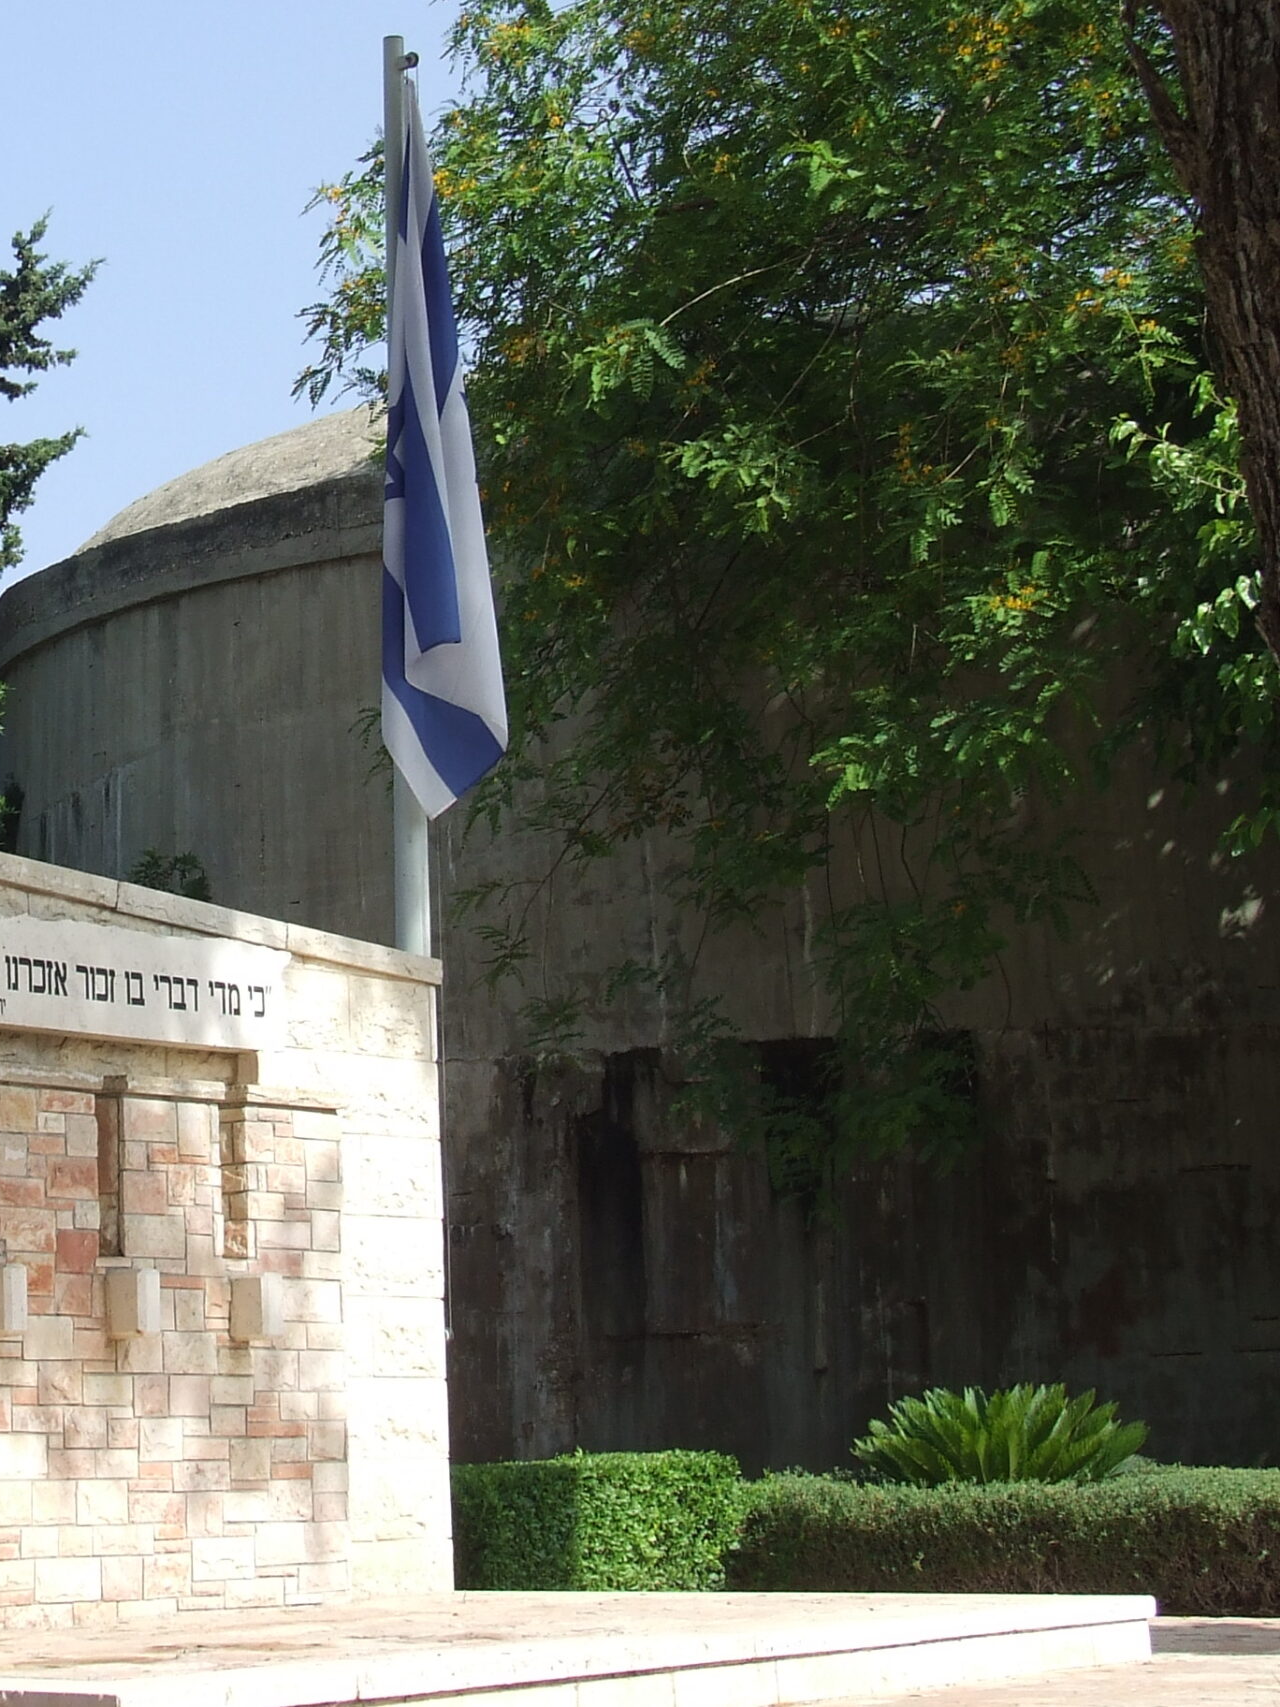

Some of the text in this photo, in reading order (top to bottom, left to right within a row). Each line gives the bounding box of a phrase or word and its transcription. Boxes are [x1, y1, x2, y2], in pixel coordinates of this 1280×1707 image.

[4, 955, 68, 997] אזכרנו
[75, 964, 115, 1003] זכור
[124, 971, 145, 1006] בו
[153, 974, 198, 1012] דברי
[208, 980, 241, 1016] מדי
